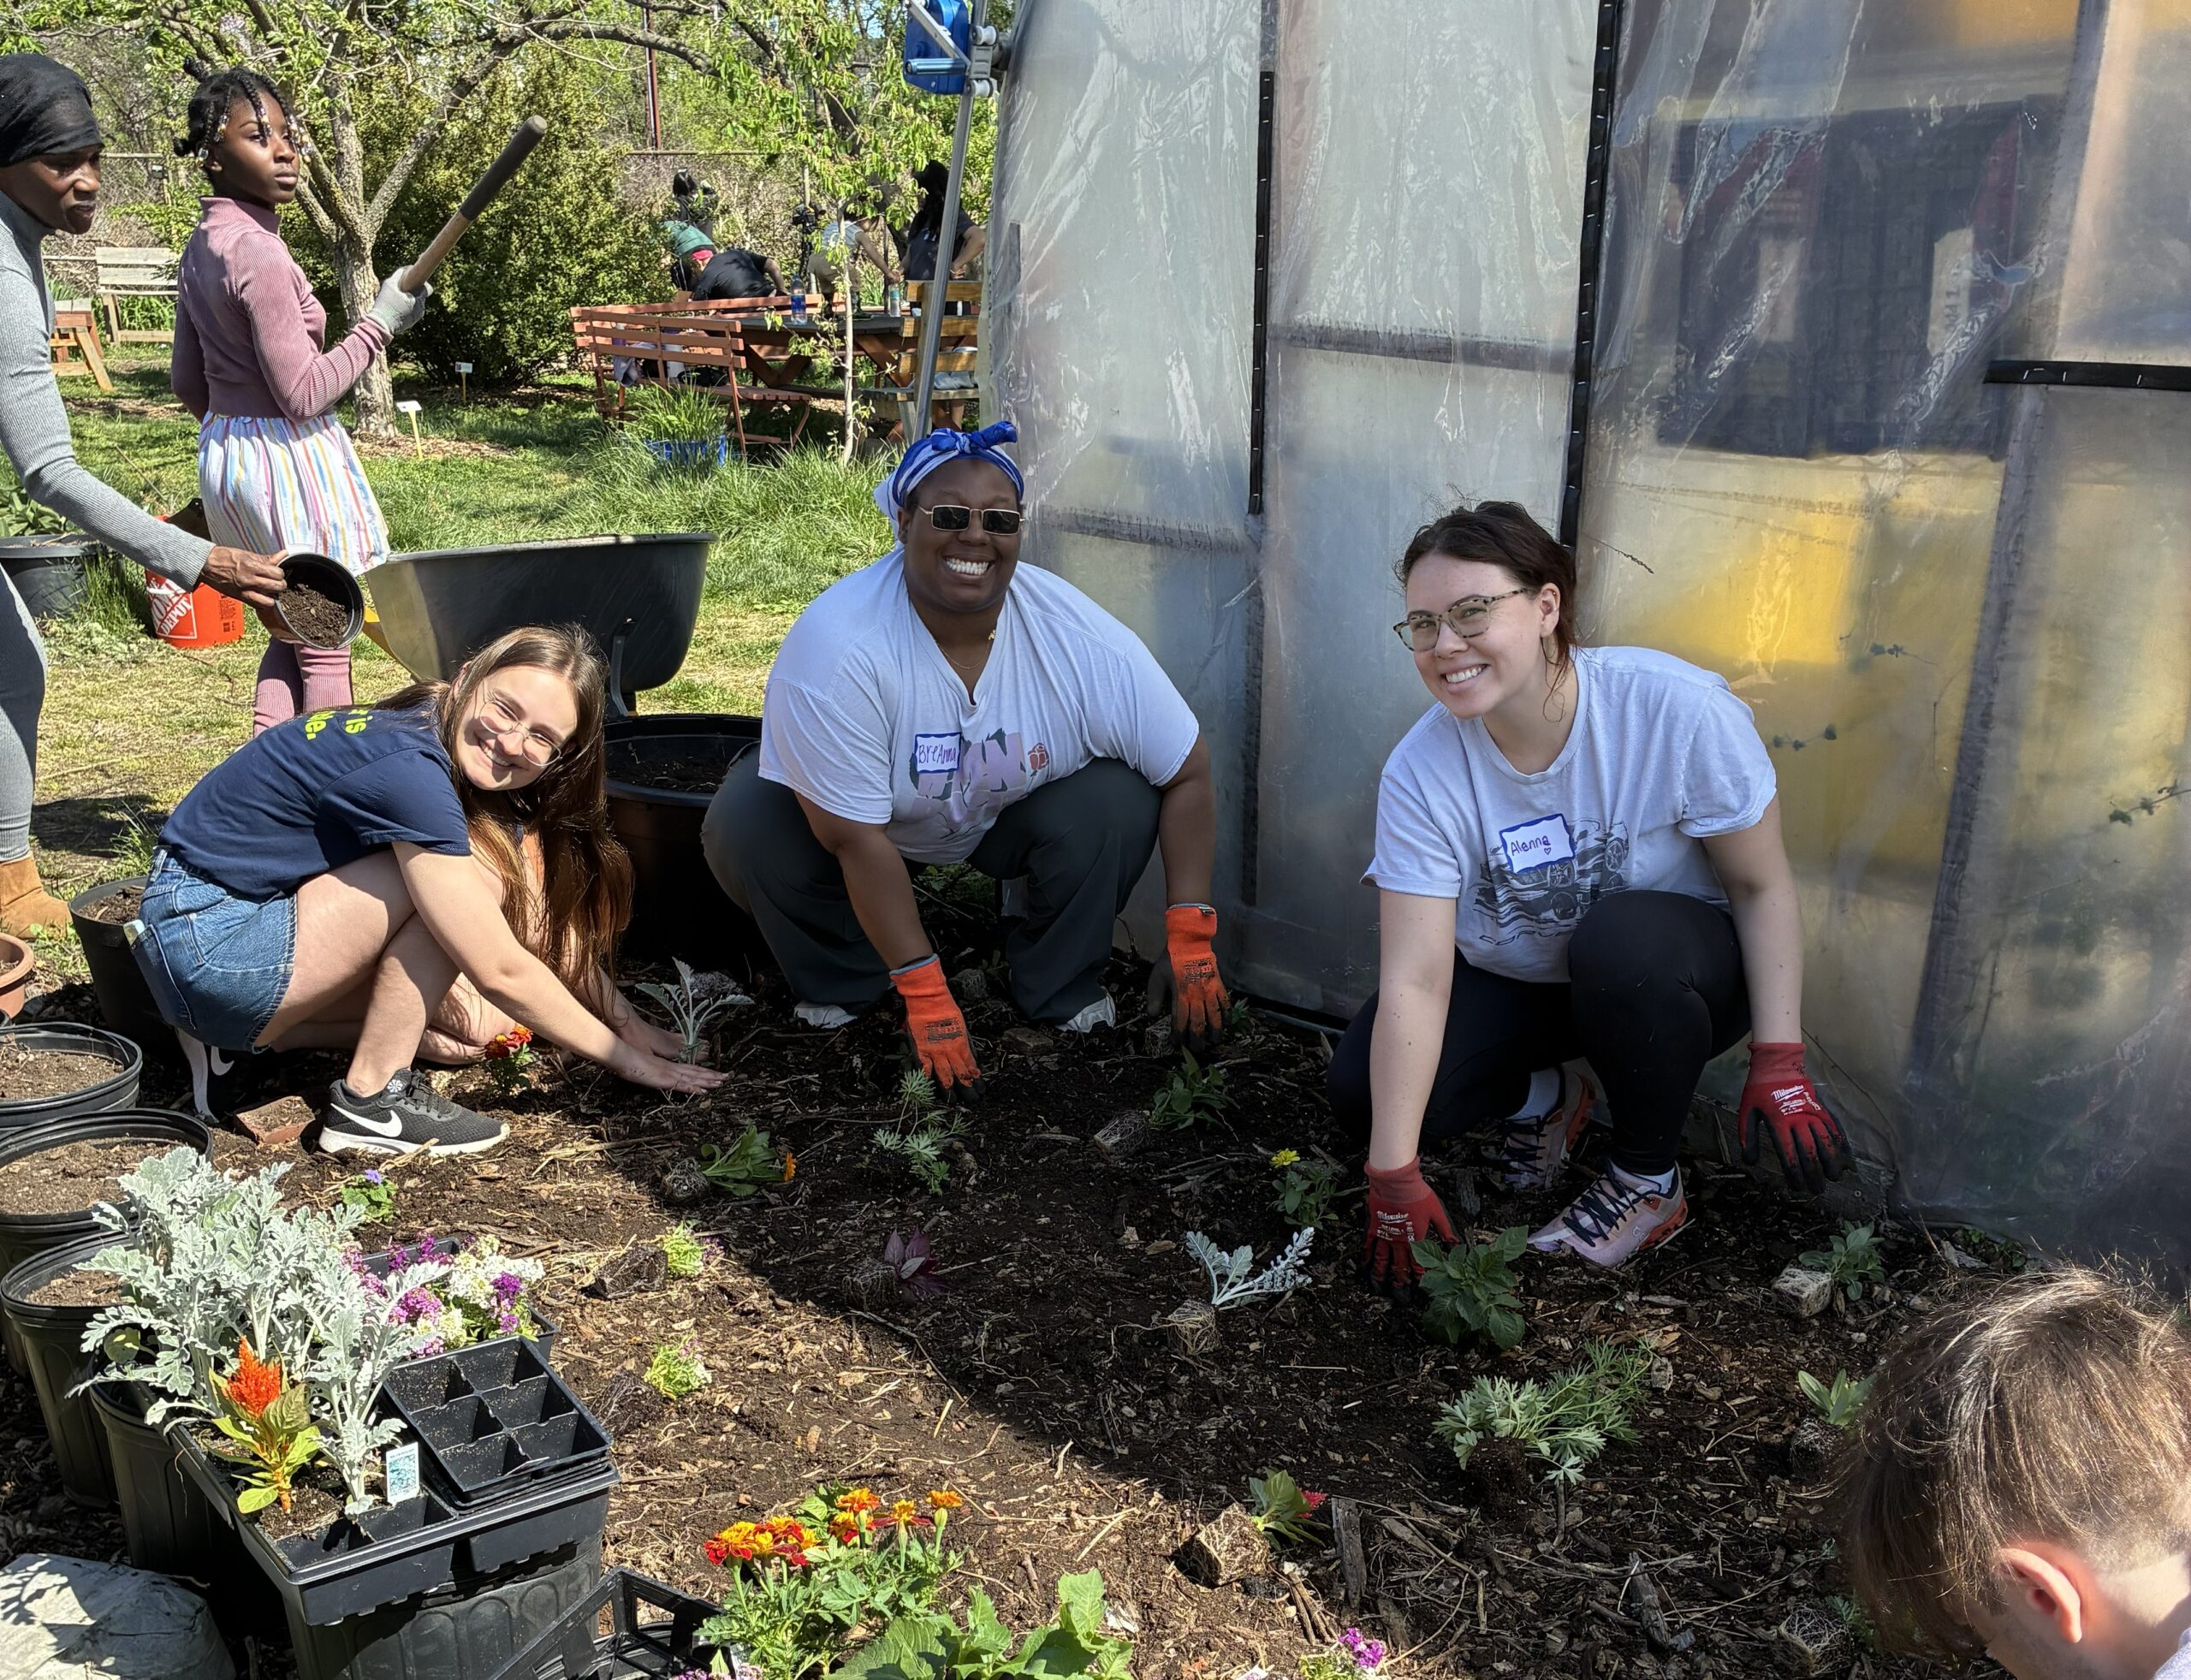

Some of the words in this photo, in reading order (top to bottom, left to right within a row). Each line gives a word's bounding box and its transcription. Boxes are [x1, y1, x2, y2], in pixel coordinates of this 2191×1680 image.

[160, 597, 192, 635] DEPOT
[345, 715, 373, 733] is
[918, 744, 957, 764] Bre'Anna
